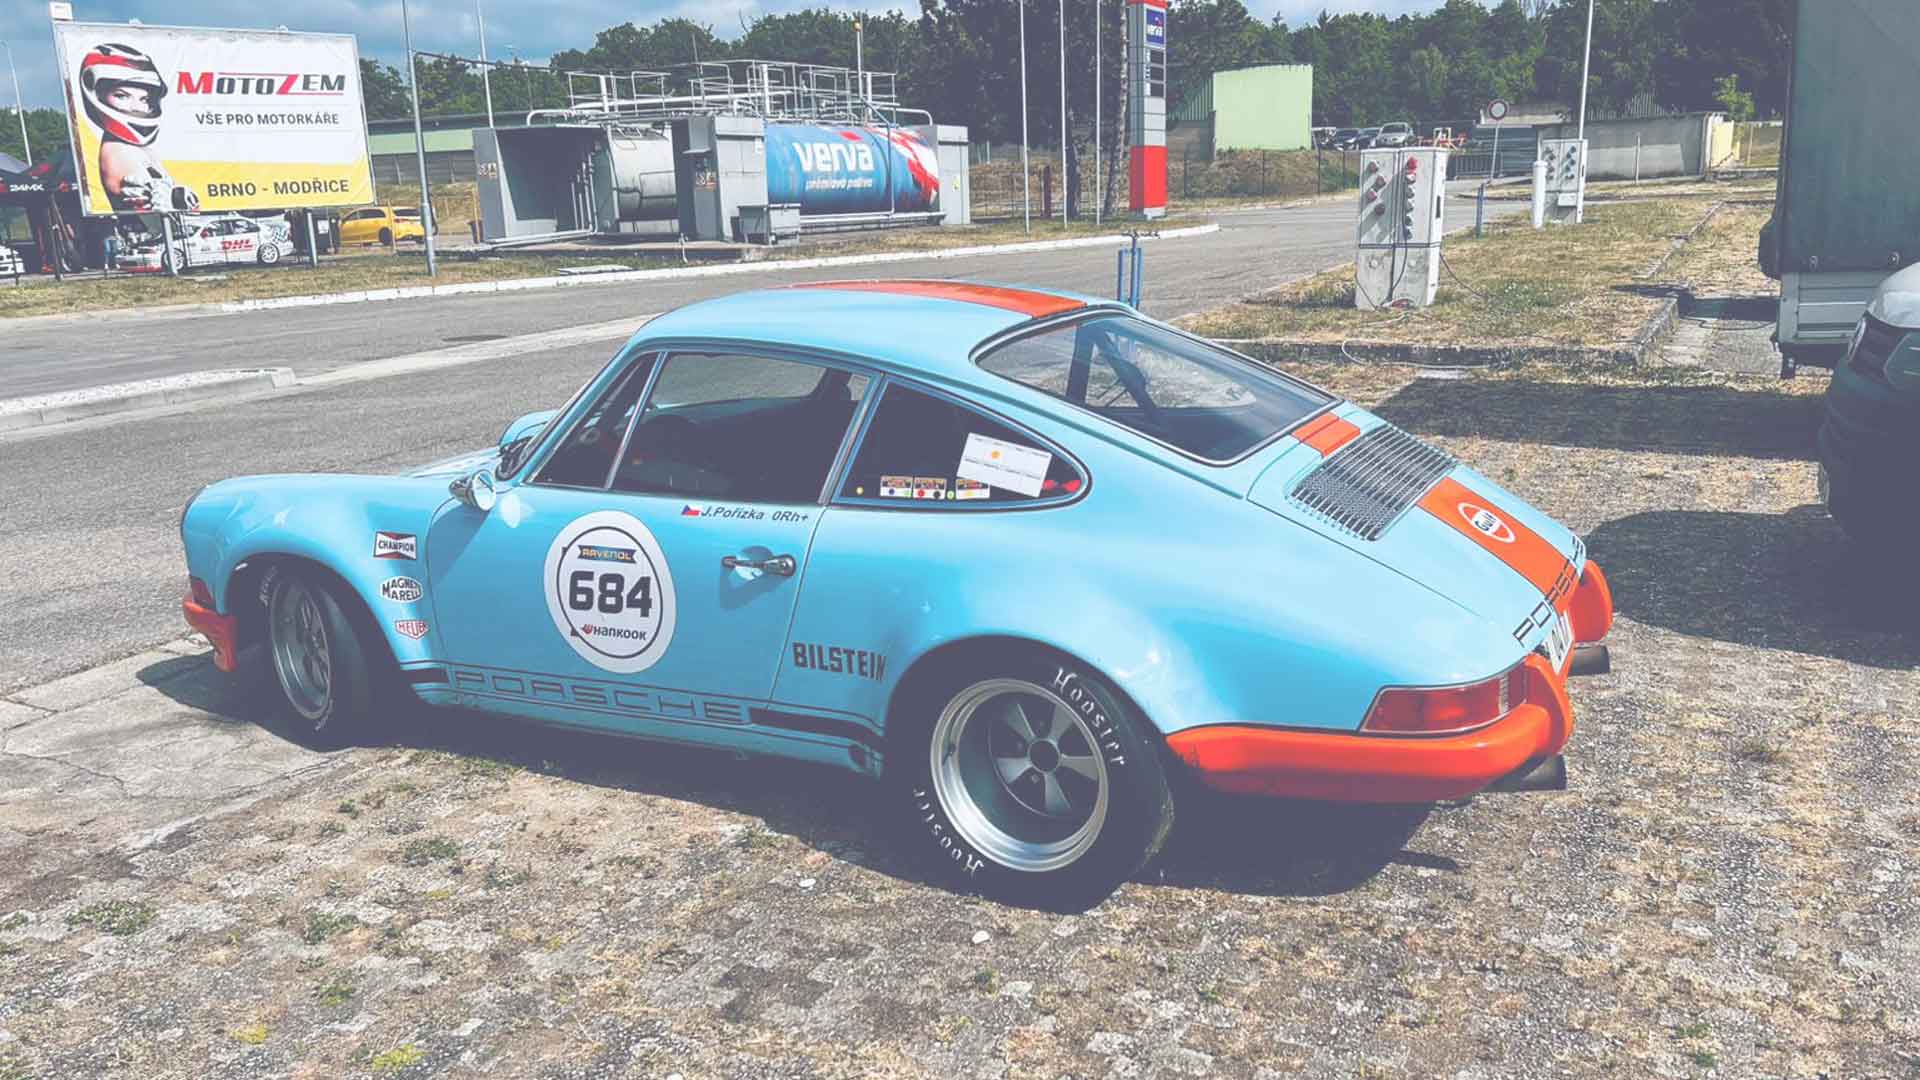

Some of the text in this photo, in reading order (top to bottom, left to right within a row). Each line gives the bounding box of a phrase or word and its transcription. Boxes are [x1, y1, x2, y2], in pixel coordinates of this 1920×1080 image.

[195, 111, 340, 125] VŠE PRO MOTORKÁŘE
[792, 142, 875, 172] verva
[207, 182, 257, 198] BRNO
[273, 176, 350, 195] MODŘICE
[377, 540, 415, 553] CHAMPION
[569, 570, 653, 618] 684
[792, 641, 887, 682] BILSTEIN
[454, 671, 744, 722] PORSCHE
